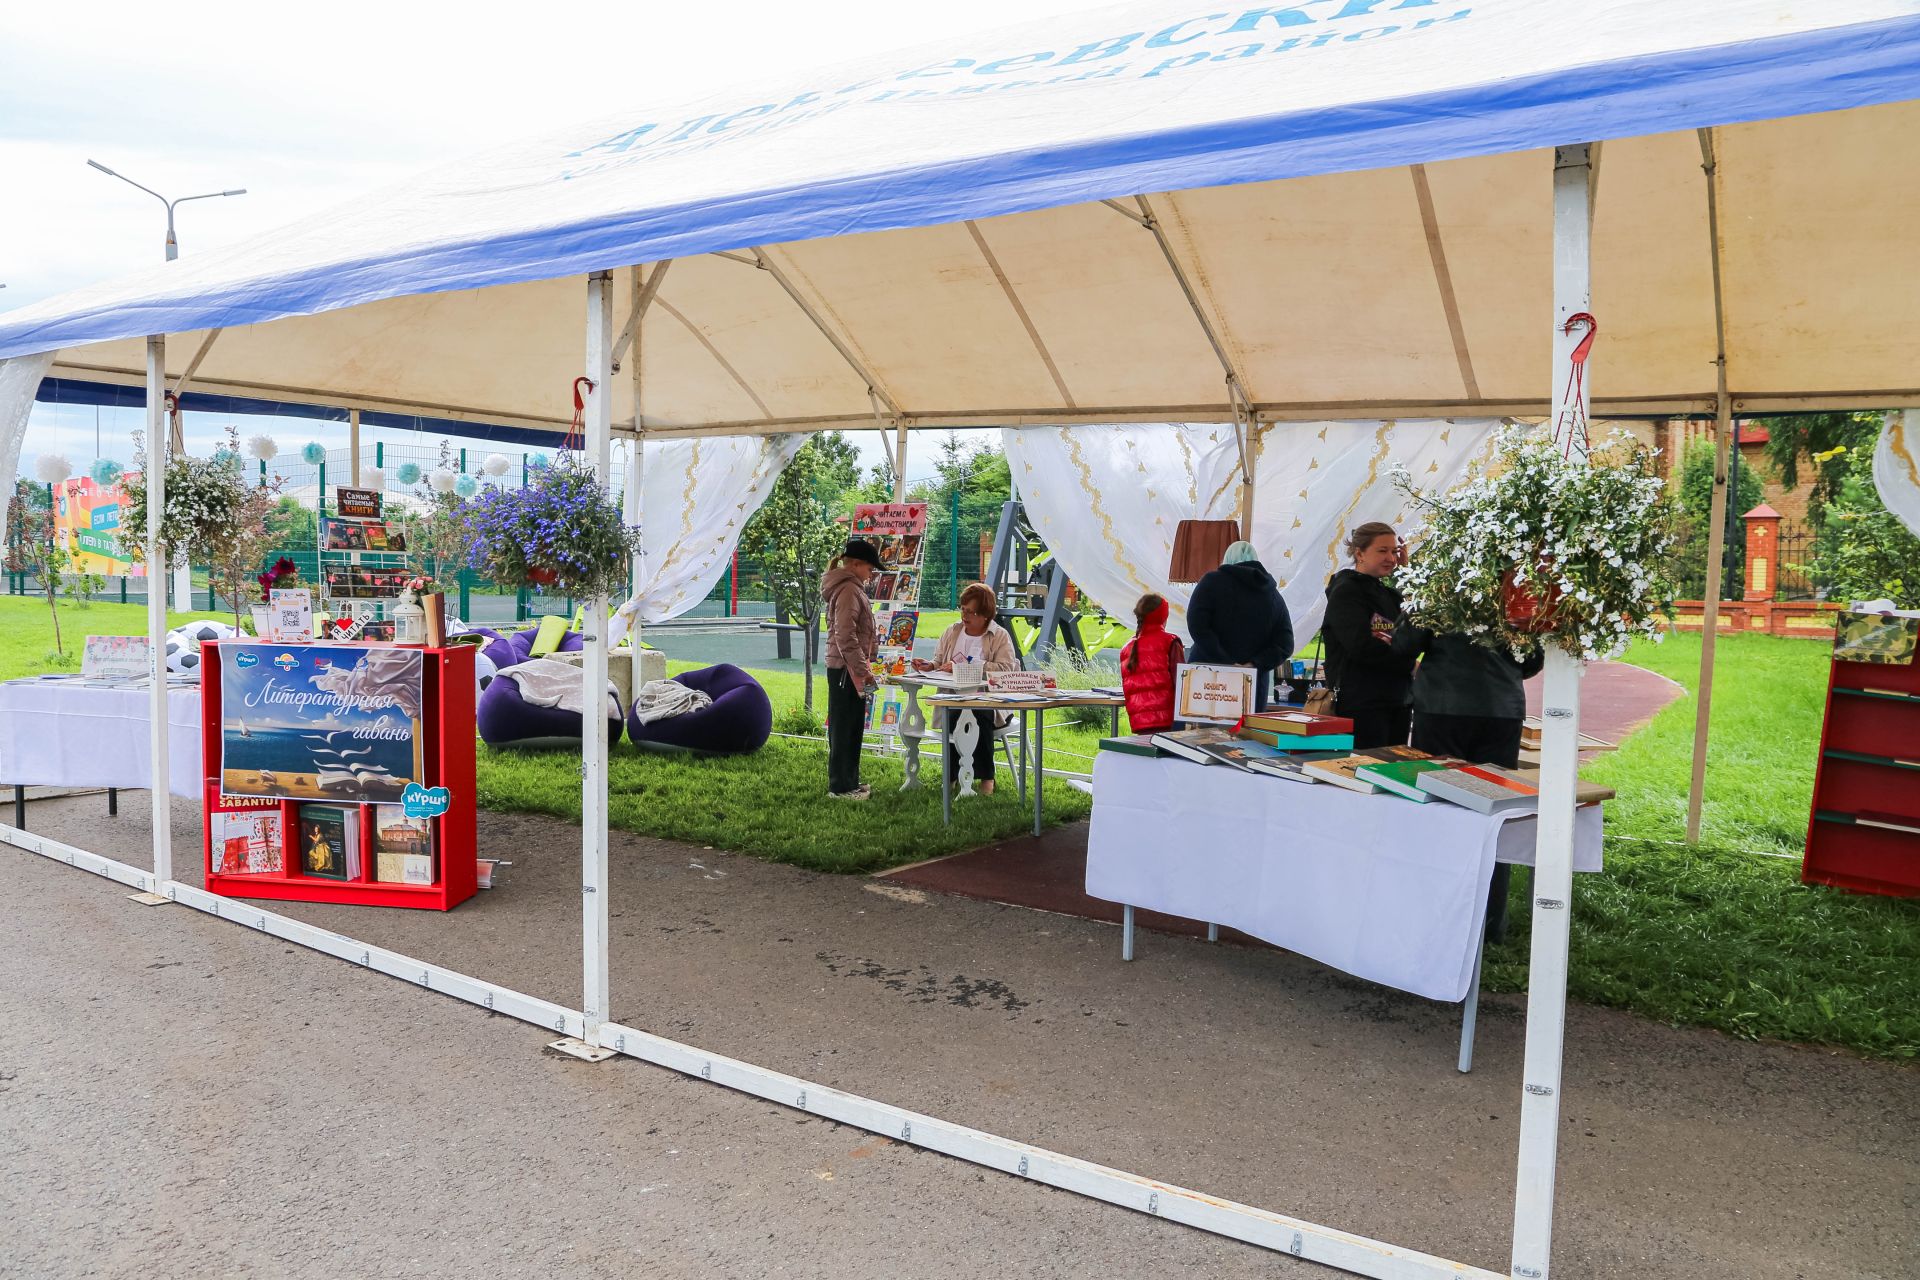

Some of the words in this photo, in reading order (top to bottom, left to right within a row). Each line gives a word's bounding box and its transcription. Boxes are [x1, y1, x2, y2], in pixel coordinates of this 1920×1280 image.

[1138, 8, 1473, 79] район
[346, 491, 370, 501] Самые
[343, 499, 374, 507] читаемые
[345, 505, 373, 514] КНИГИ
[333, 628, 341, 636] Я
[341, 614, 370, 641] ЧИТАТЬ
[1203, 682, 1227, 691] КНИГИ
[244, 677, 394, 716] Литературная
[1193, 692, 1202, 700] СО
[1204, 693, 1239, 702] СТАТУСОМ
[352, 714, 412, 742] гавань
